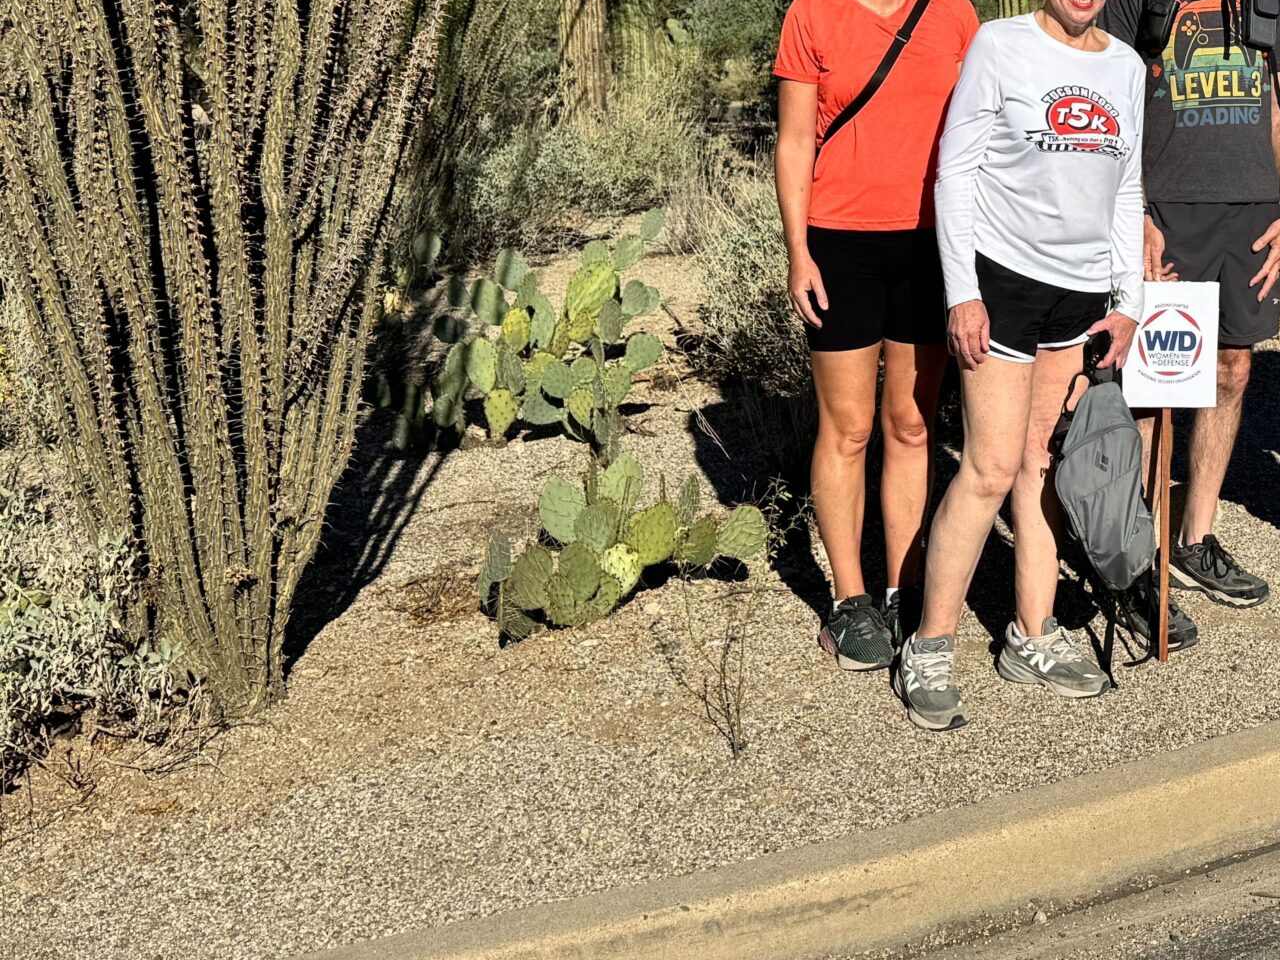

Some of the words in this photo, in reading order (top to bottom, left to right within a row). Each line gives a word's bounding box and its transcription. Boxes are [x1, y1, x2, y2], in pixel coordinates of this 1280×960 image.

[1169, 70, 1245, 101] LEVEL
[1251, 70, 1262, 97] 3
[1041, 85, 1090, 104] TUCSON
[1091, 91, 1120, 117] 5000
[1056, 102, 1109, 133] T5K
[1175, 106, 1261, 128] LOADING
[1144, 330, 1197, 351] WID
[1148, 352, 1180, 360] WOMEN
[1158, 359, 1190, 367] DEFENSE
